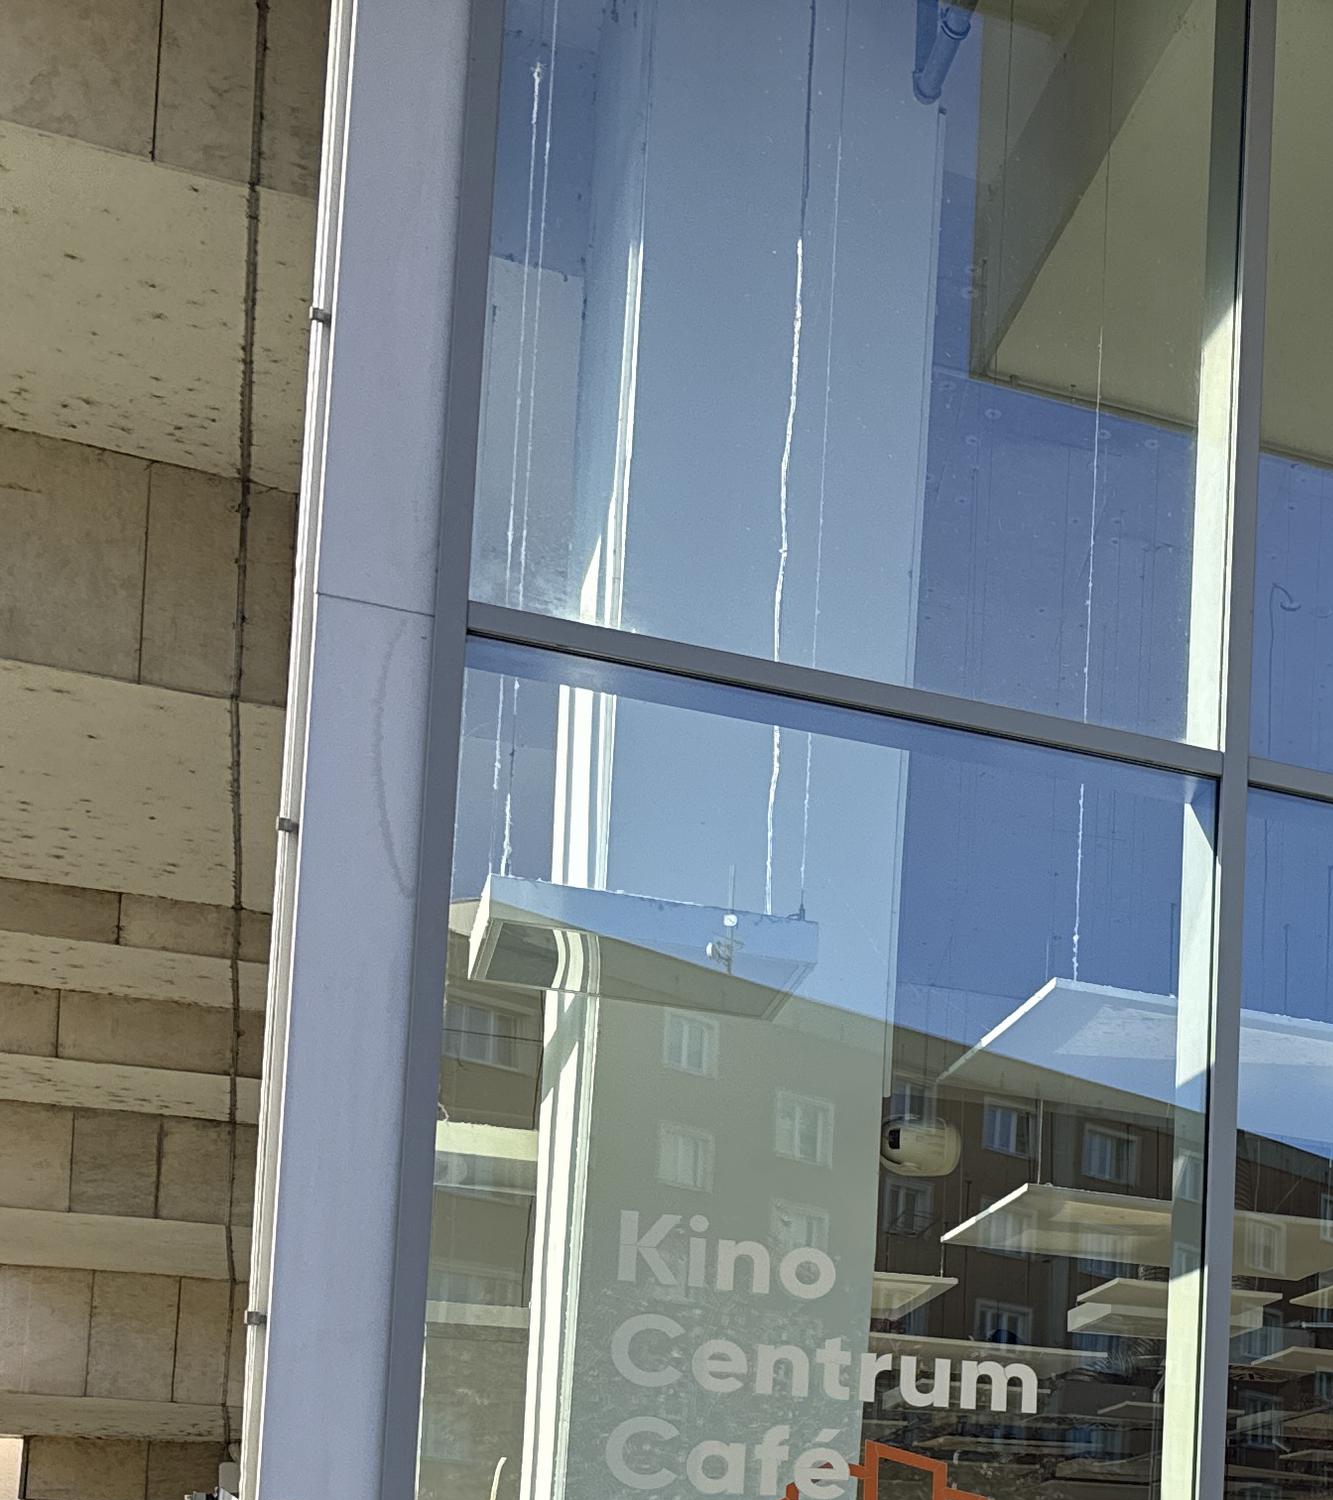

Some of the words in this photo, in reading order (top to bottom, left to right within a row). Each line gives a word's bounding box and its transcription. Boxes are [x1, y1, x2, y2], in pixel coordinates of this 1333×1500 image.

[616, 1209, 837, 1300] Kino
[610, 1313, 1039, 1415] Centrum
[605, 1416, 851, 1500] Café
